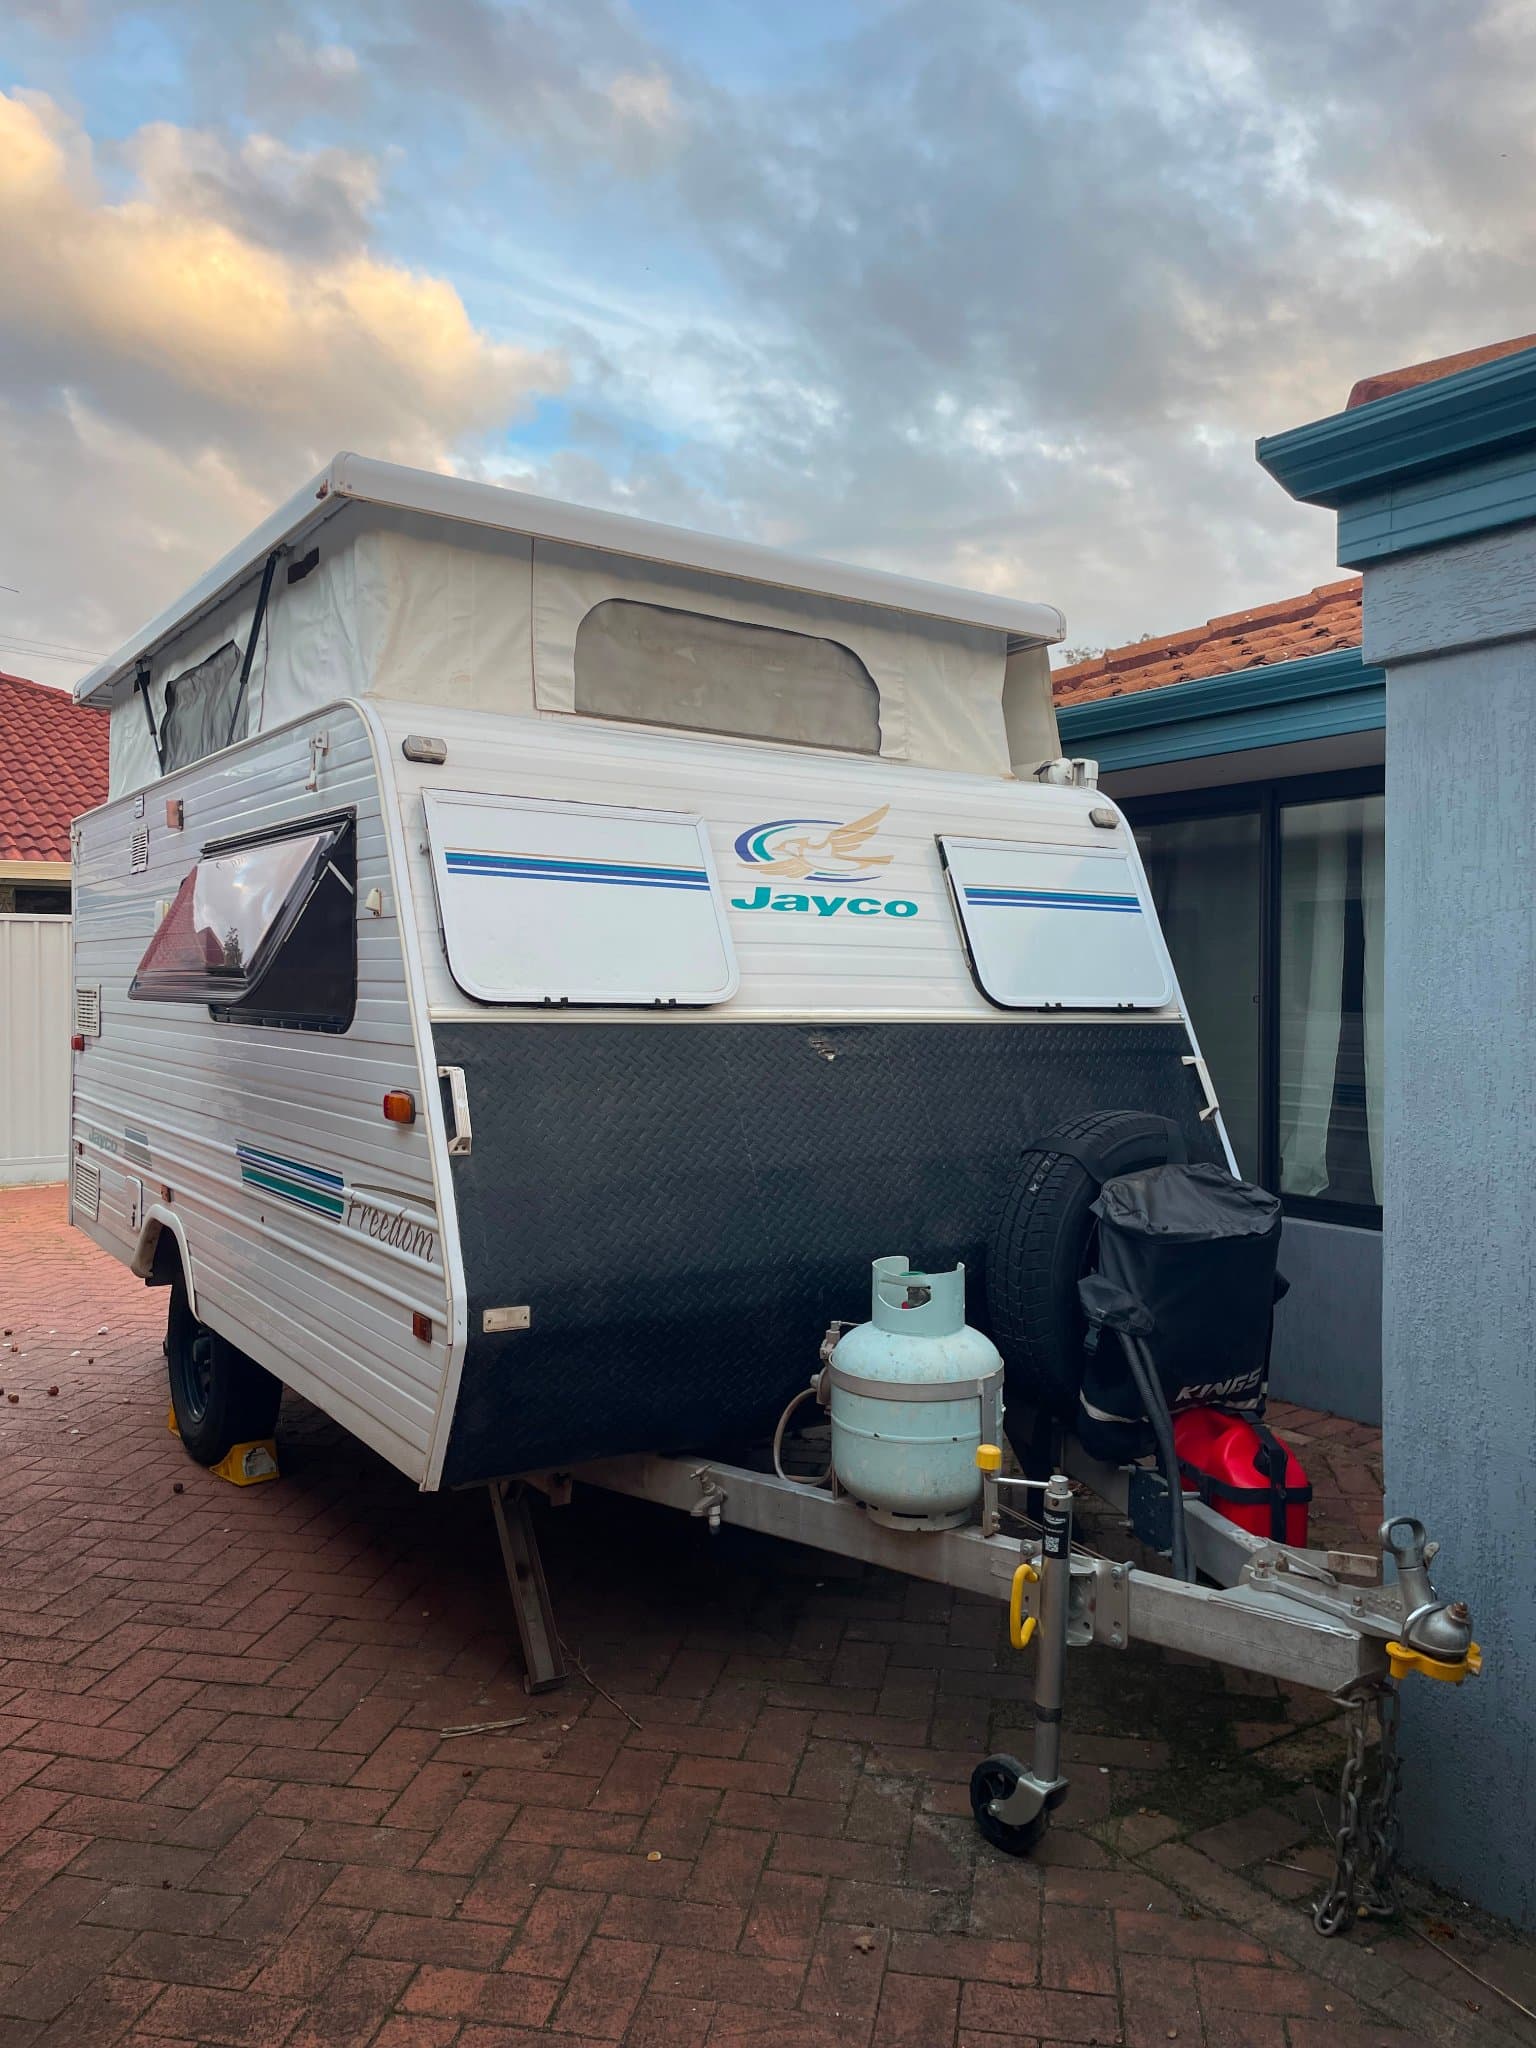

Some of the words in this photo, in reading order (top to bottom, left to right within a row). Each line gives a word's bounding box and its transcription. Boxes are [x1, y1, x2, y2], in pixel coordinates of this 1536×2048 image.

[731, 886, 919, 918] Jayco
[346, 1191, 434, 1263] Freedom
[1175, 1367, 1262, 1402] KINGS
